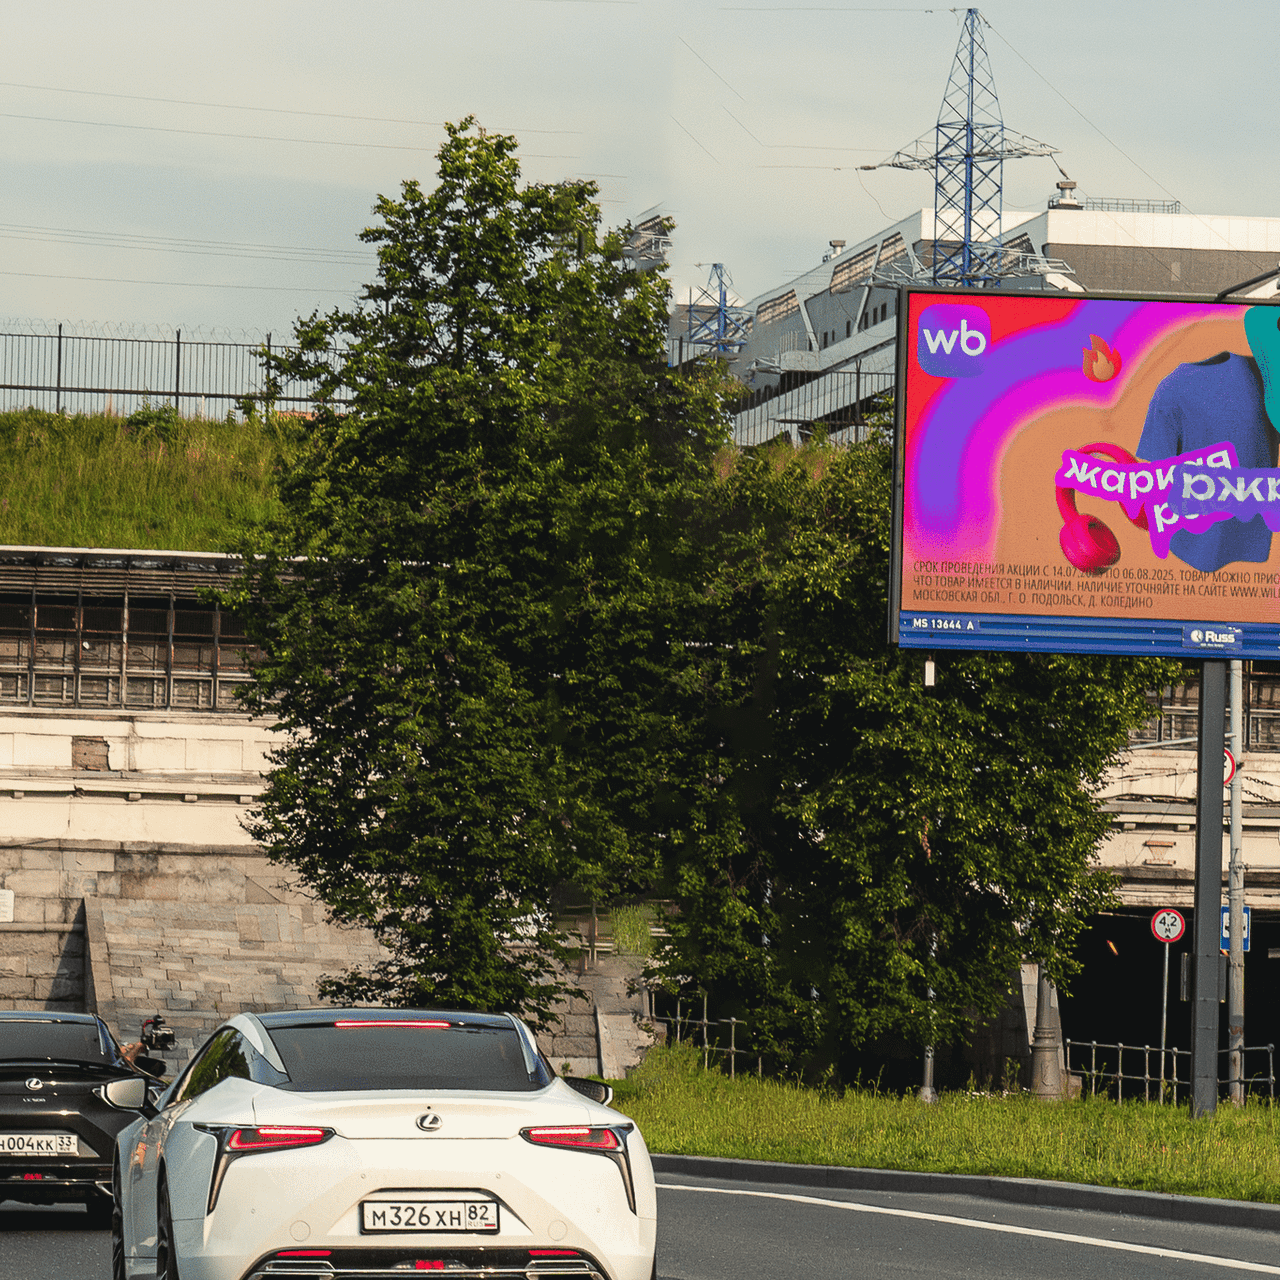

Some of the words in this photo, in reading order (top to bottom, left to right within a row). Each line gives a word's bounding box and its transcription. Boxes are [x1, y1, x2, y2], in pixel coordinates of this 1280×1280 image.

[923, 318, 987, 357] wb
[913, 560, 938, 573] СРОК
[940, 561, 1005, 576] ПРОВЕДЕНИЯ
[1007, 563, 1040, 577] АКЦИИ
[1042, 565, 1050, 577] С
[1180, 569, 1210, 582] ТОВАР
[1212, 571, 1251, 584] МОЖНО
[913, 575, 933, 586] ЧТО
[935, 575, 966, 588] ТОВАР
[967, 577, 1012, 589] ИМЕЕТСЯ
[1014, 578, 1022, 590] В
[1077, 580, 1123, 593] НАЛИЧИЕ
[1125, 581, 1180, 596] УТОЧНЯЙТЕ
[1182, 584, 1196, 596] НА
[1198, 583, 1228, 597] САЙТЕ
[1230, 585, 1280, 599] WWW.WIL
[912, 589, 978, 602] МОСКОВСКАЯ
[1100, 595, 1154, 610] КОЛЕДИНО
[913, 617, 928, 628] MS
[931, 619, 962, 630] 13644
[966, 620, 975, 631] A
[1205, 630, 1236, 643] Russ
[1159, 916, 1177, 927] 4,2
[58, 1136, 72, 1147] 33
[468, 1205, 489, 1221] 82
[468, 1220, 484, 1228] RUS
